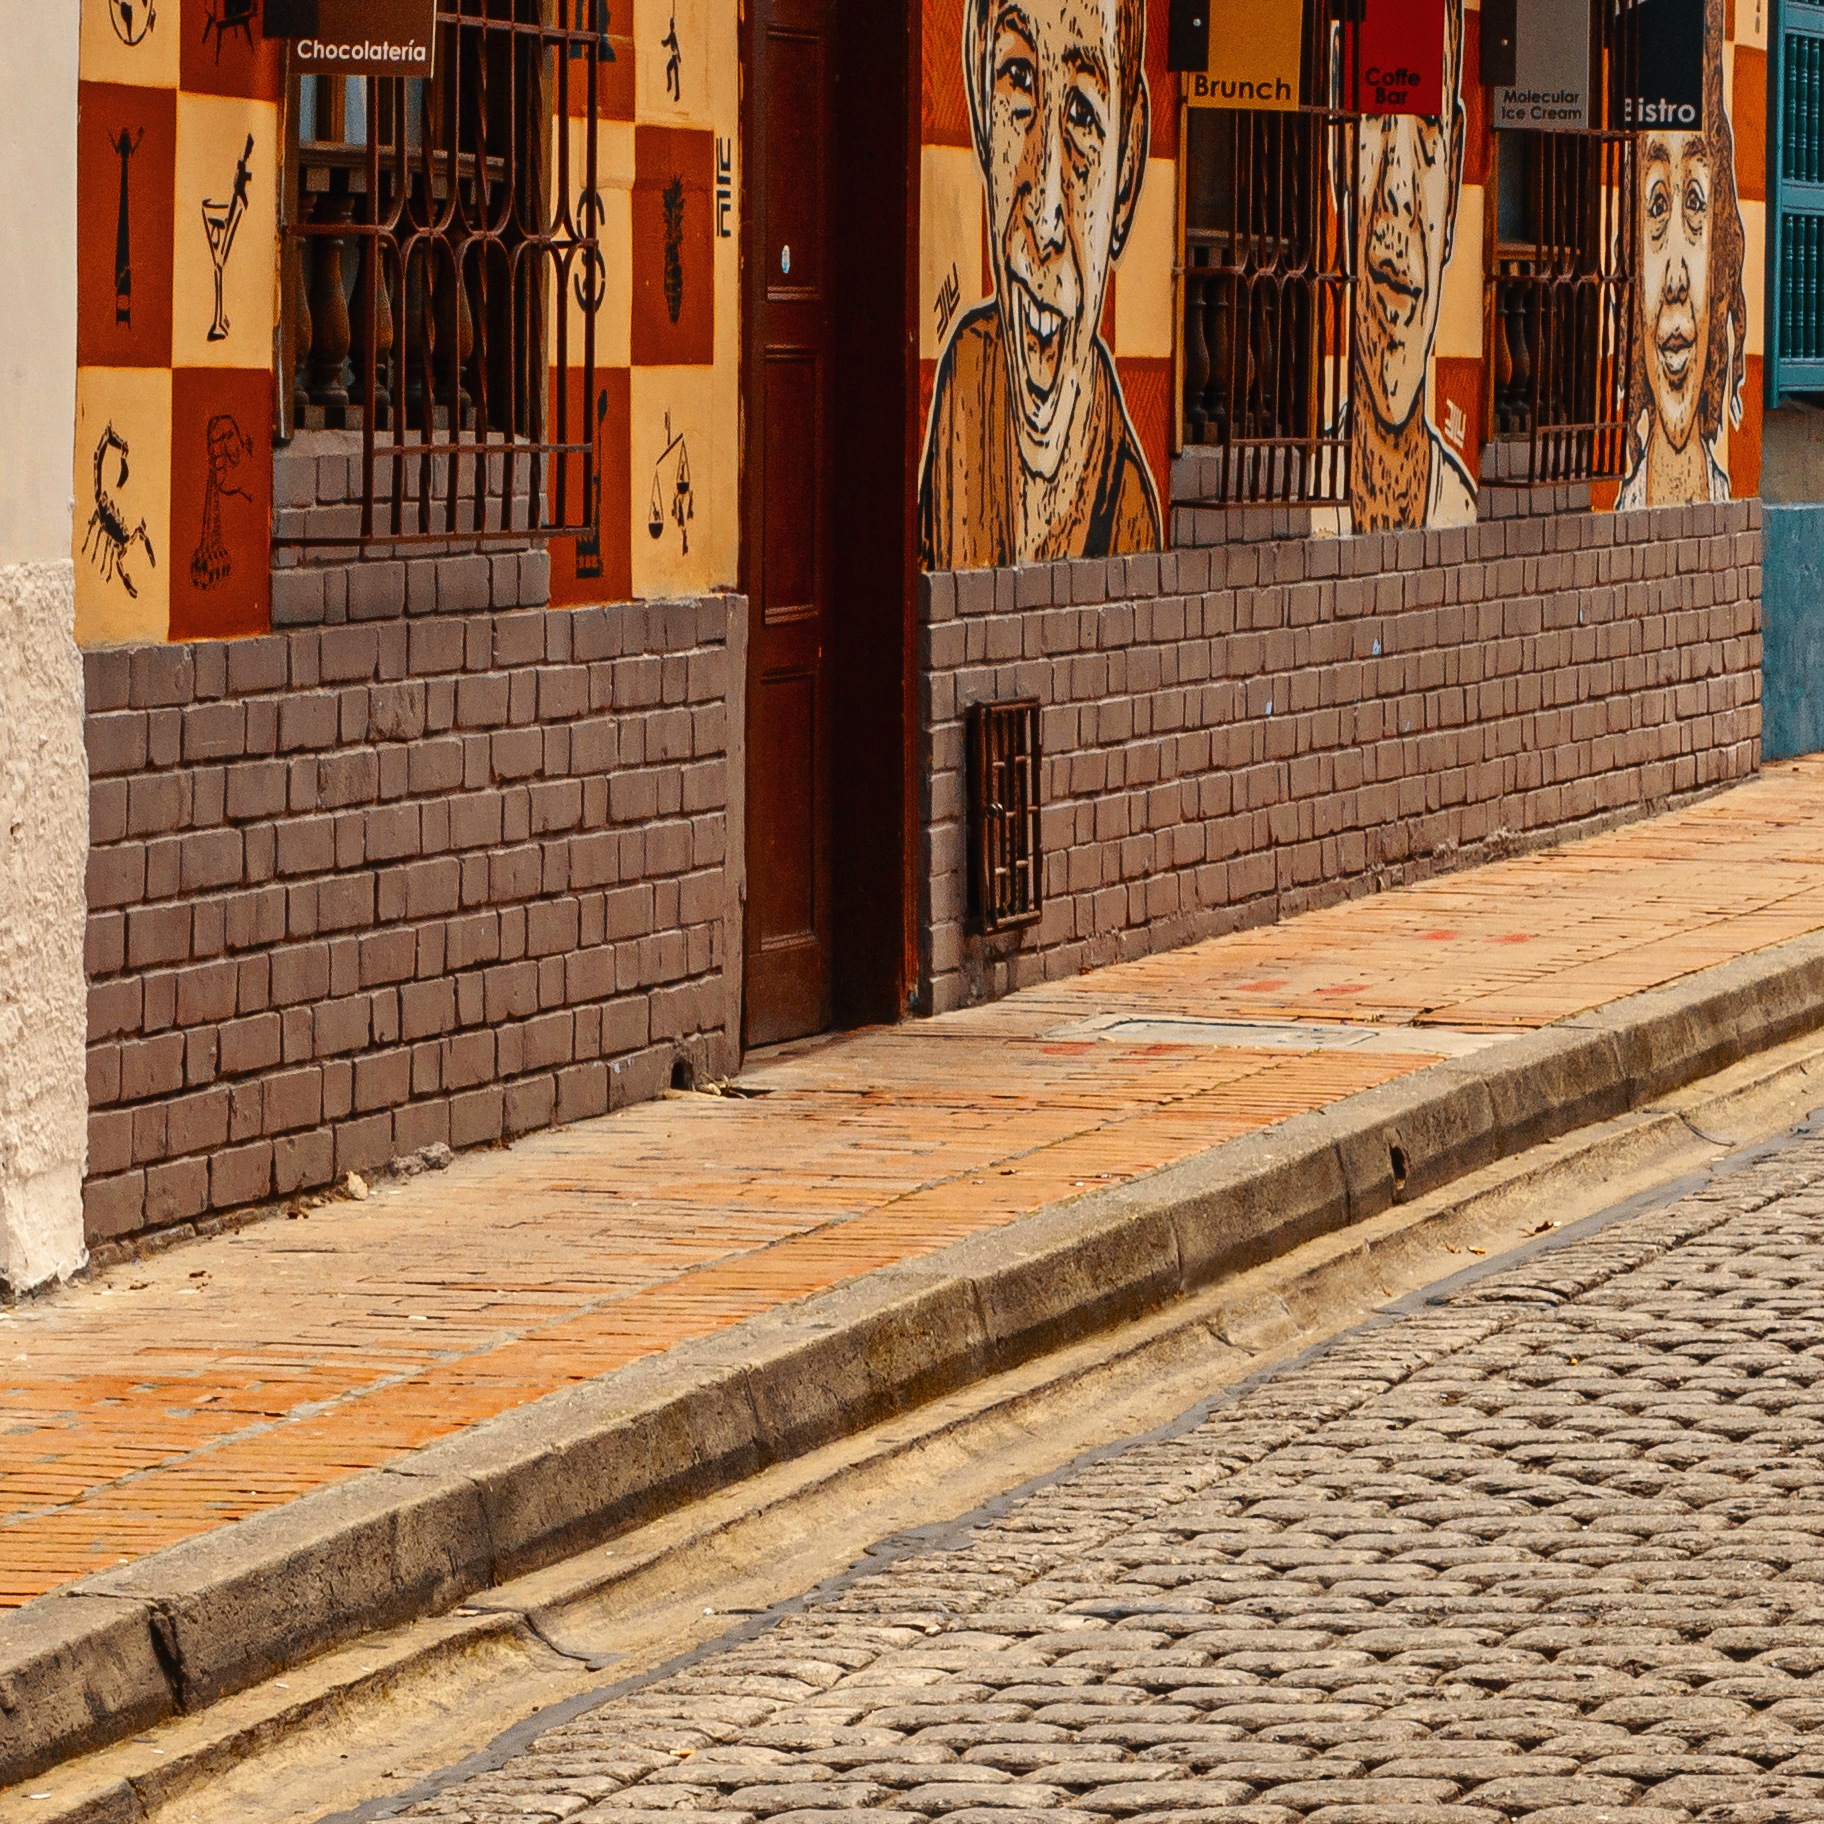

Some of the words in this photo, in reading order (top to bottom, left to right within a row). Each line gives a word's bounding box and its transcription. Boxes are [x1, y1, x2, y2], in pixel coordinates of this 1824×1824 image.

[297, 38, 426, 62] Chocolatería
[1365, 67, 1421, 86] Coffe
[1194, 74, 1291, 101] Brunch
[1375, 86, 1408, 105] Bar
[1502, 89, 1580, 104] Molecular
[1501, 106, 1526, 120] Ice
[1530, 106, 1582, 120] Cream
